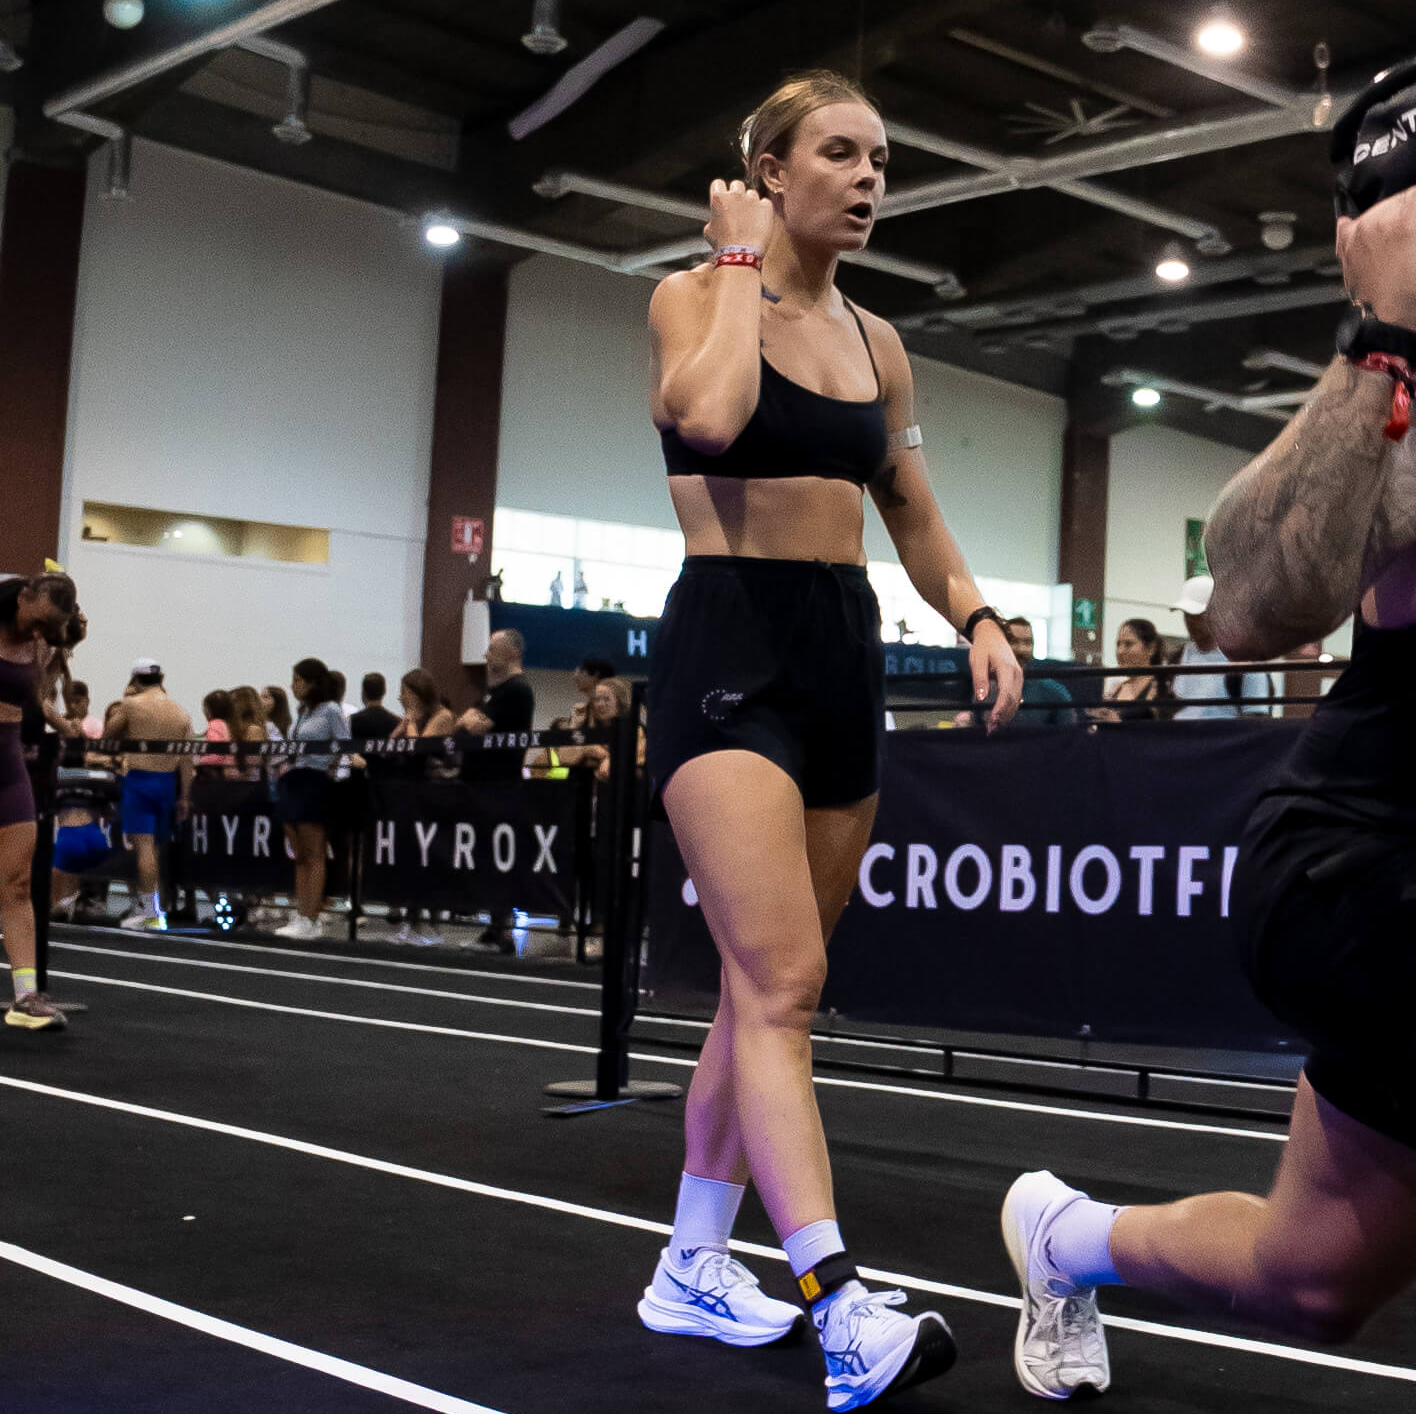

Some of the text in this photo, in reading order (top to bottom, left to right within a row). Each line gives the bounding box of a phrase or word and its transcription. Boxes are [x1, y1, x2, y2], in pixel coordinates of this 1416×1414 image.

[484, 732, 541, 748] HYROX
[193, 814, 335, 860] HYR
[375, 819, 559, 874] HYROX
[858, 842, 1239, 918] CROBIOTFI
